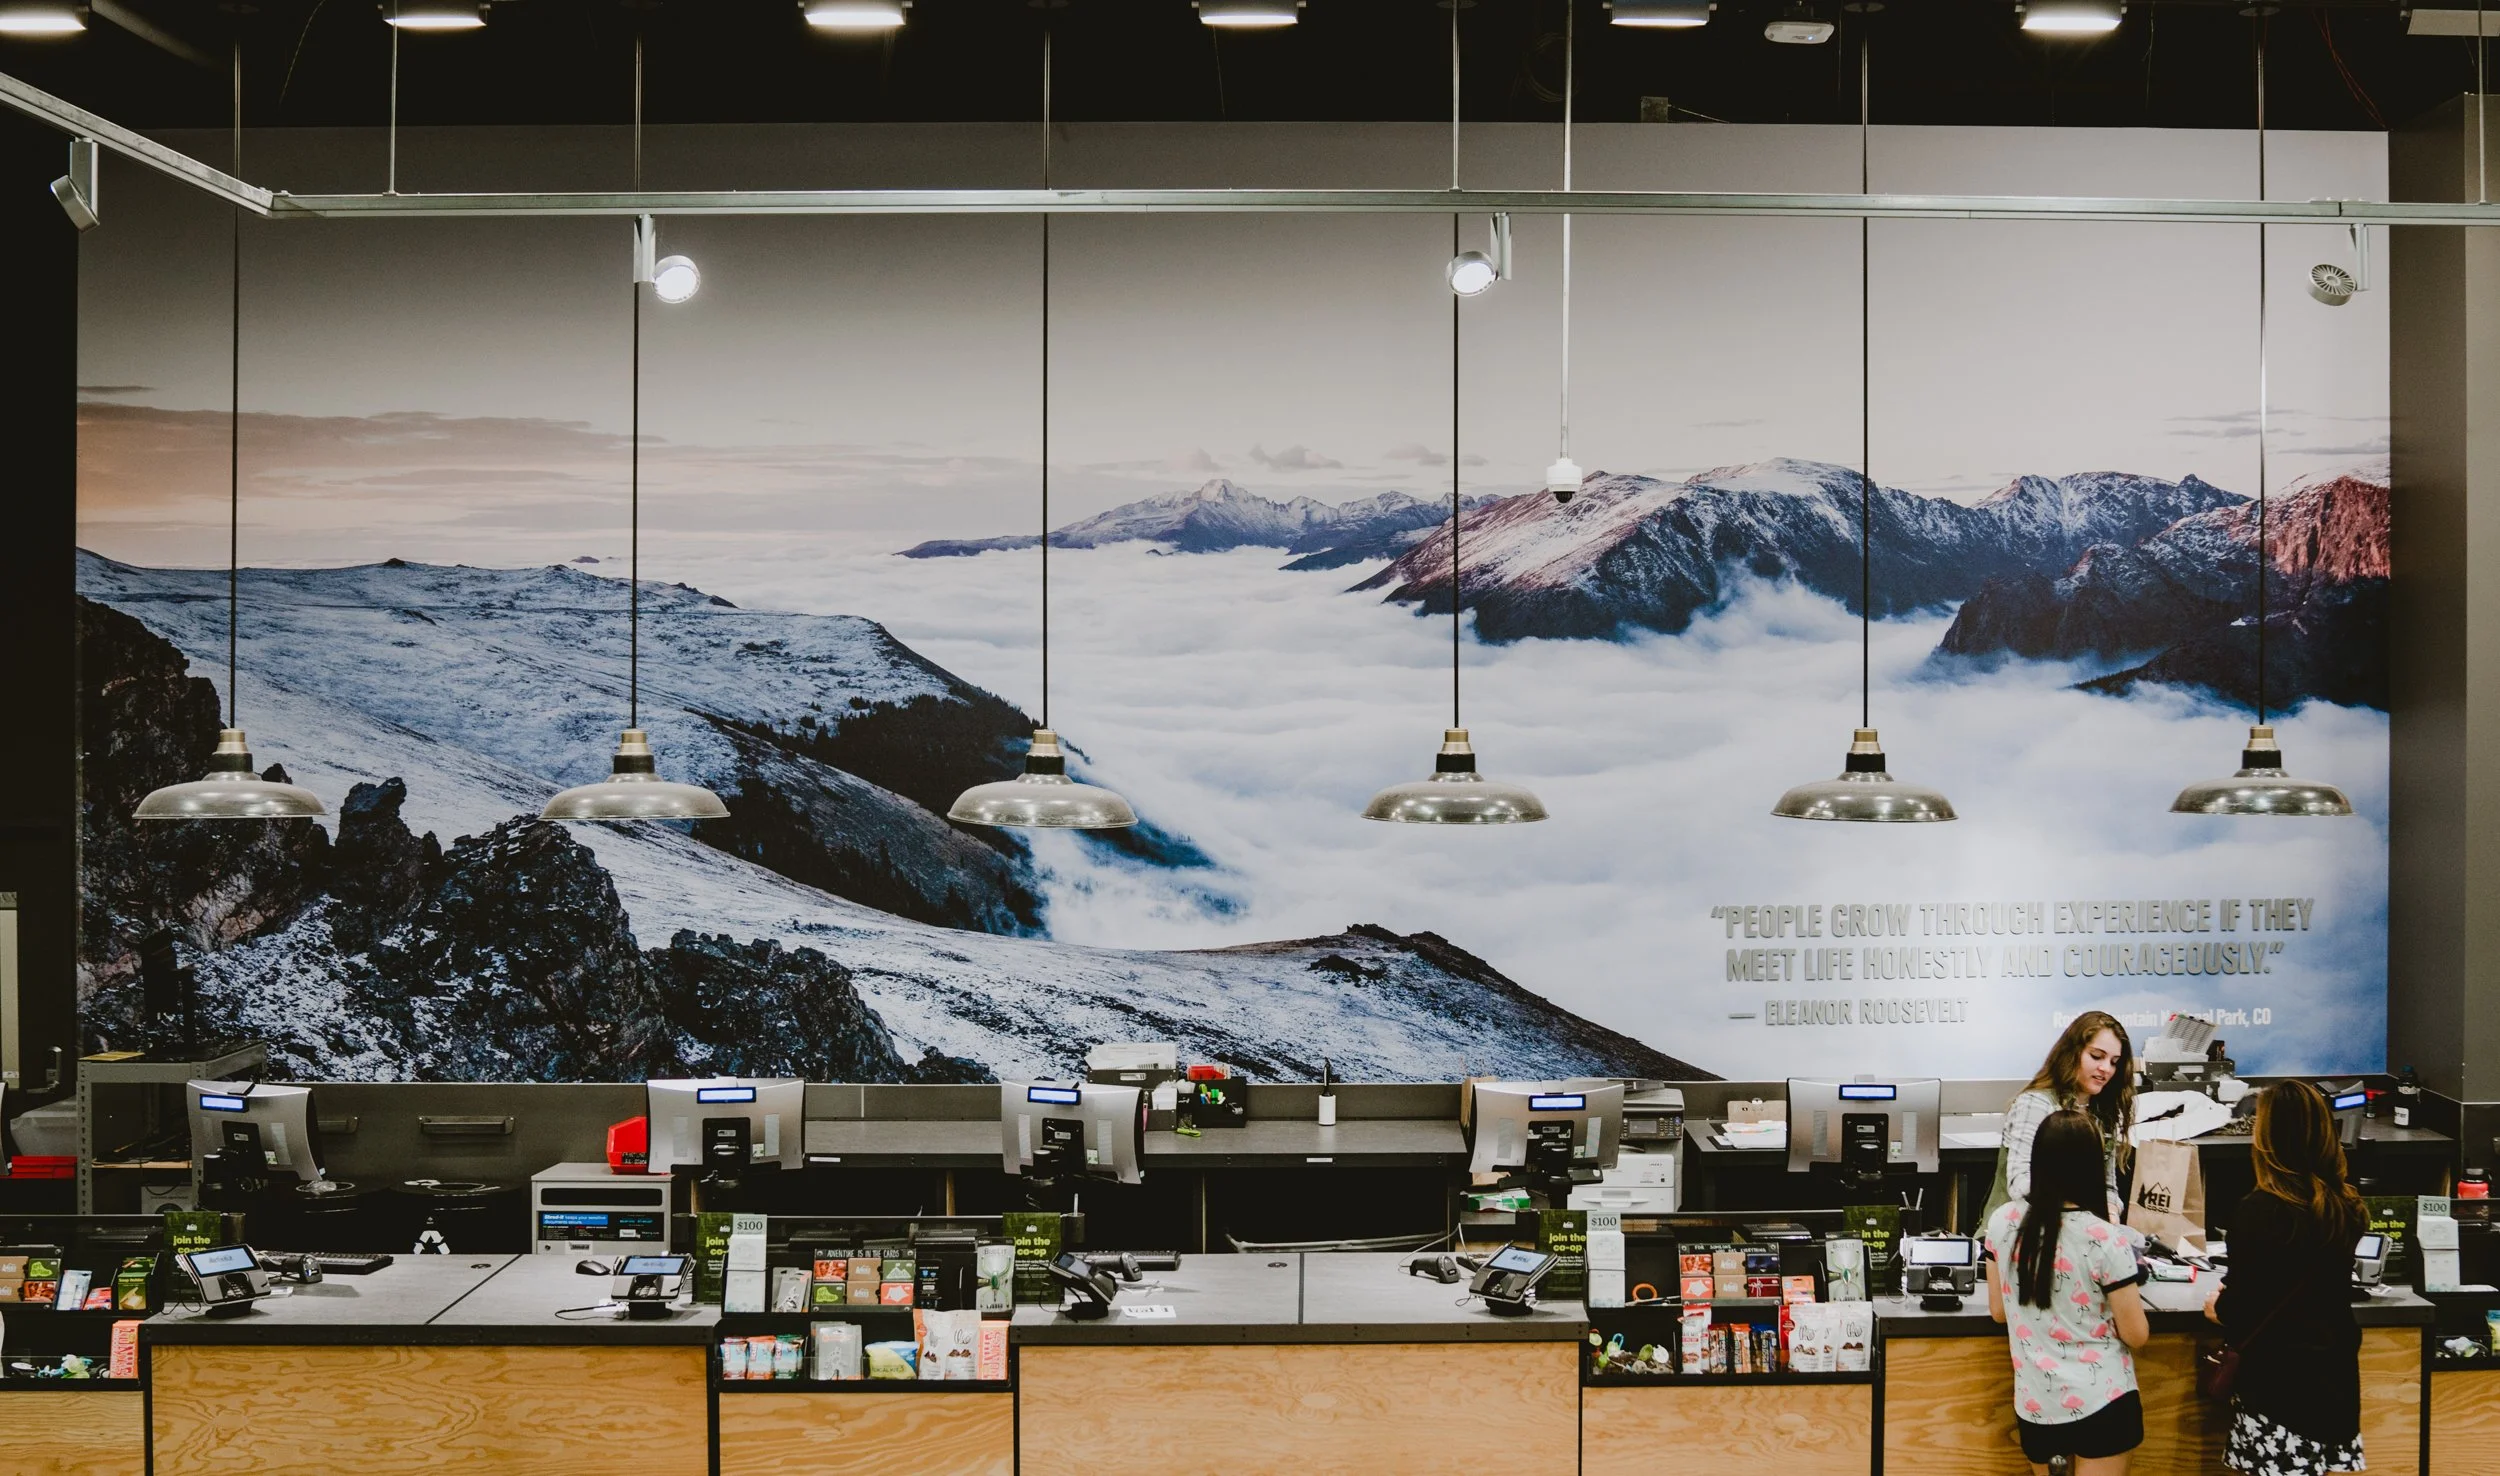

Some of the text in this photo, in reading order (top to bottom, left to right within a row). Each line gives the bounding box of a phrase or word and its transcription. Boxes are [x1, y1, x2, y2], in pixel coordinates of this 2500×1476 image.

[1831, 903, 1911, 937] GROW
[1920, 903, 2044, 936] THROUGH
[2054, 900, 2211, 933] EXPERIENCE
[2220, 899, 2241, 932] IF
[2249, 898, 2315, 931] THEY
[1726, 949, 1796, 982] MEET
[1804, 948, 1853, 981] LIFE
[1863, 947, 1993, 980] HONESTLY
[2001, 945, 2052, 977] AND
[1765, 1000, 1853, 1026] ELEANOR
[1859, 999, 1968, 1024] ROOSEVELT
[2217, 1008, 2249, 1027] Park,
[2252, 1008, 2272, 1025] CO
[2148, 1193, 2171, 1208] REI
[2423, 1203, 2447, 1212] $100
[737, 1221, 763, 1231] $100
[1591, 1217, 1617, 1227] $100
[2369, 1220, 2406, 1230] join the
[1549, 1233, 1587, 1244] join the
[1873, 1229, 1890, 1238] the
[173, 1235, 211, 1246] join the
[706, 1236, 725, 1248] join
[1033, 1236, 1050, 1246] the
[826, 1250, 900, 1258] ADVENTURE IS IN THE CARDS
[1017, 1247, 1046, 1258] co-op
[1553, 1244, 1582, 1253] co-op
